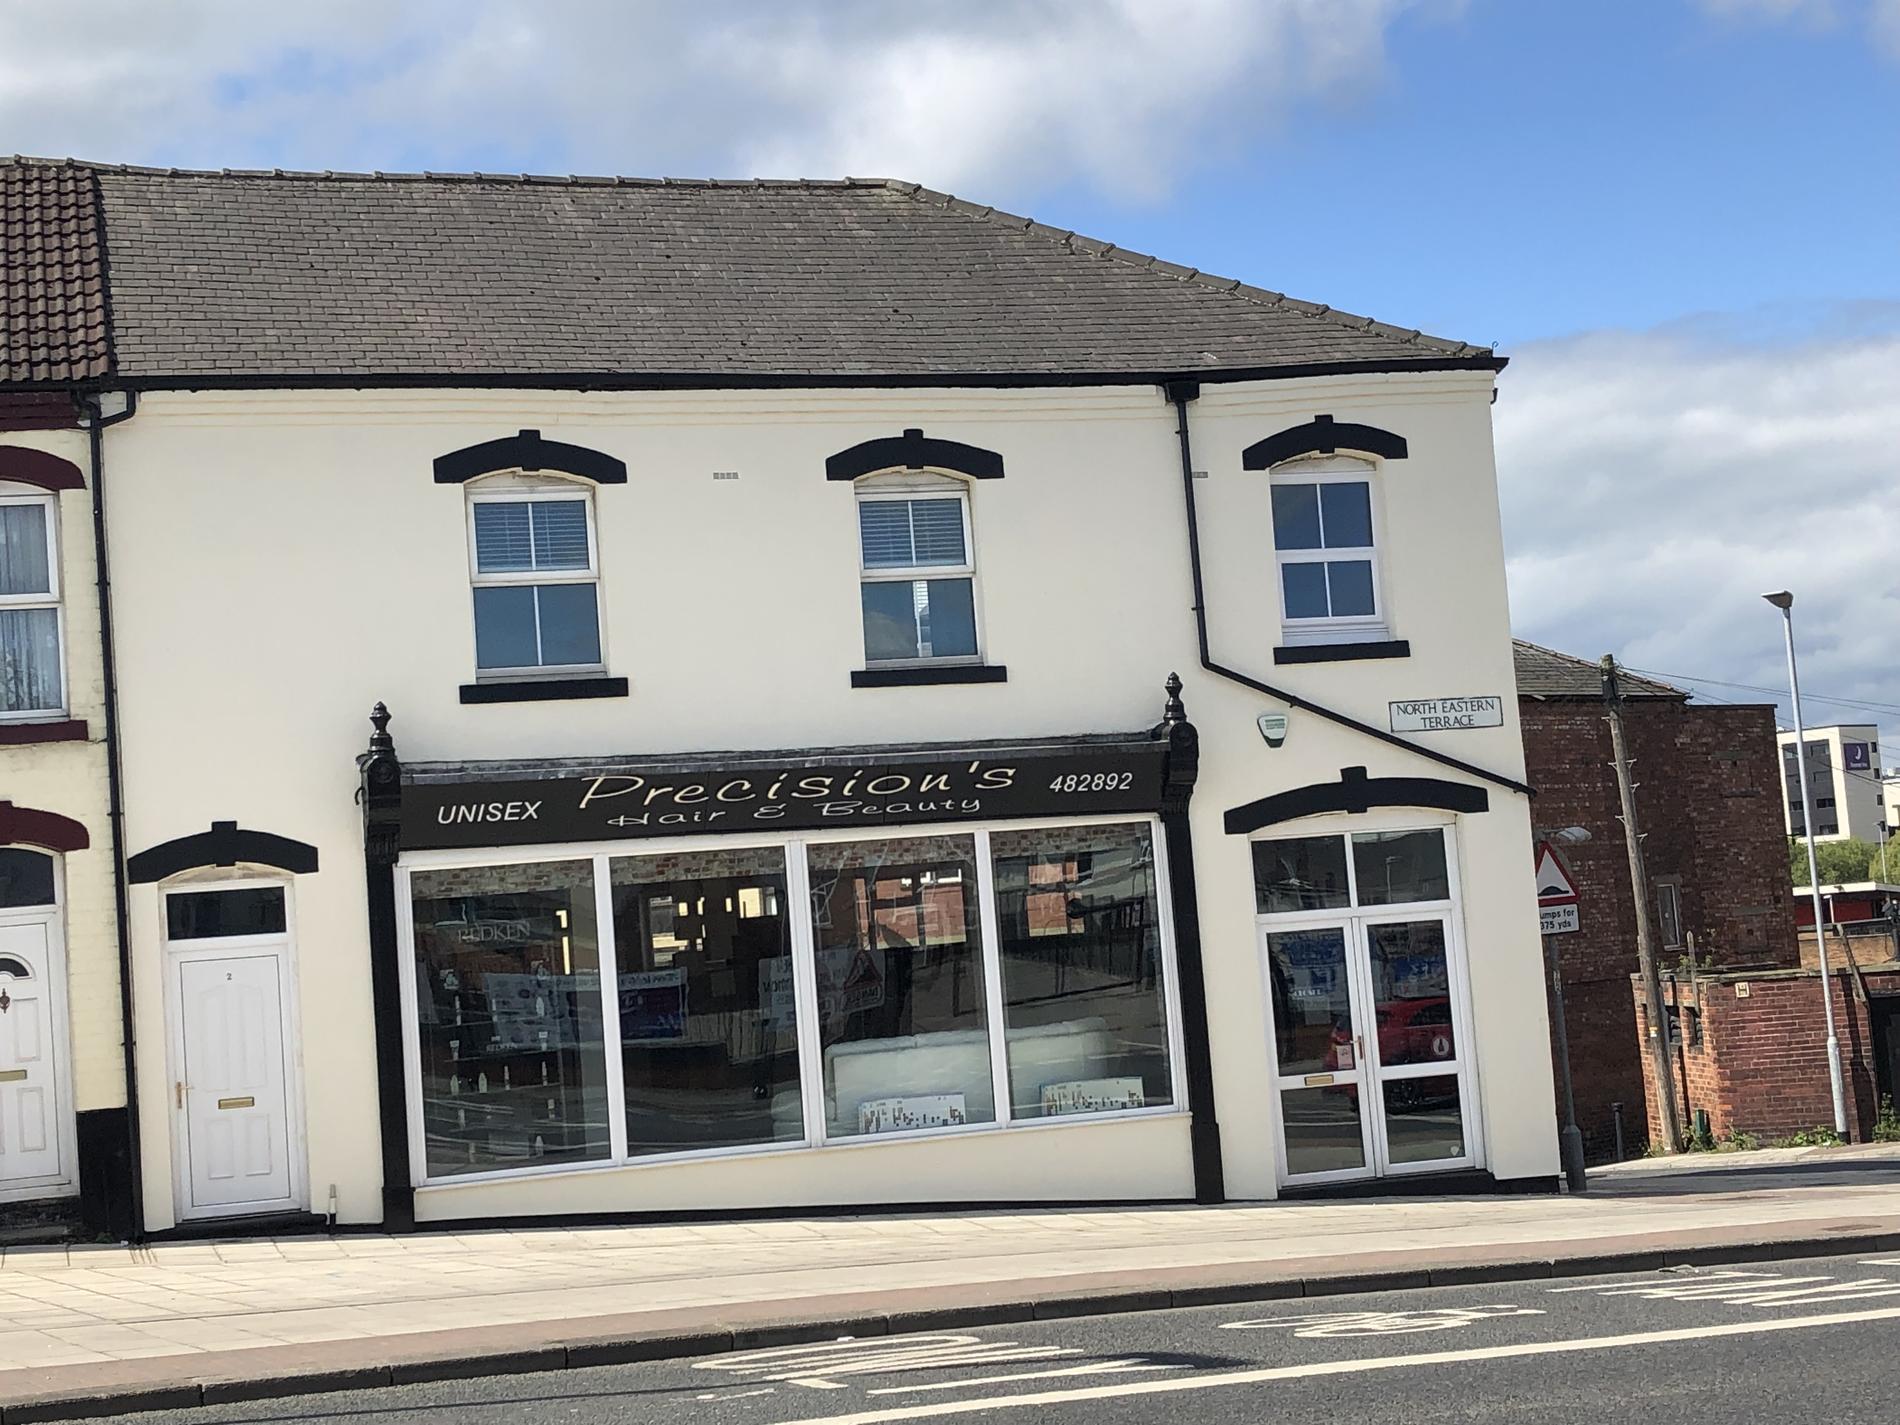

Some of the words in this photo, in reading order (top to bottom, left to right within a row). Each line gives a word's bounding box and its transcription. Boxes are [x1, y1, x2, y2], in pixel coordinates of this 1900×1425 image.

[1396, 701, 1437, 716] NORTH
[1441, 699, 1495, 713] EASTERN
[1420, 714, 1475, 728] TERRACE
[578, 761, 1017, 809] Precision's
[1049, 772, 1134, 794] 482892
[437, 801, 543, 824] UNISEX
[606, 809, 727, 828] Hair
[813, 799, 981, 817] Beauty
[1540, 910, 1561, 919] umps
[1563, 908, 1575, 917] for
[226, 972, 233, 981] 2
